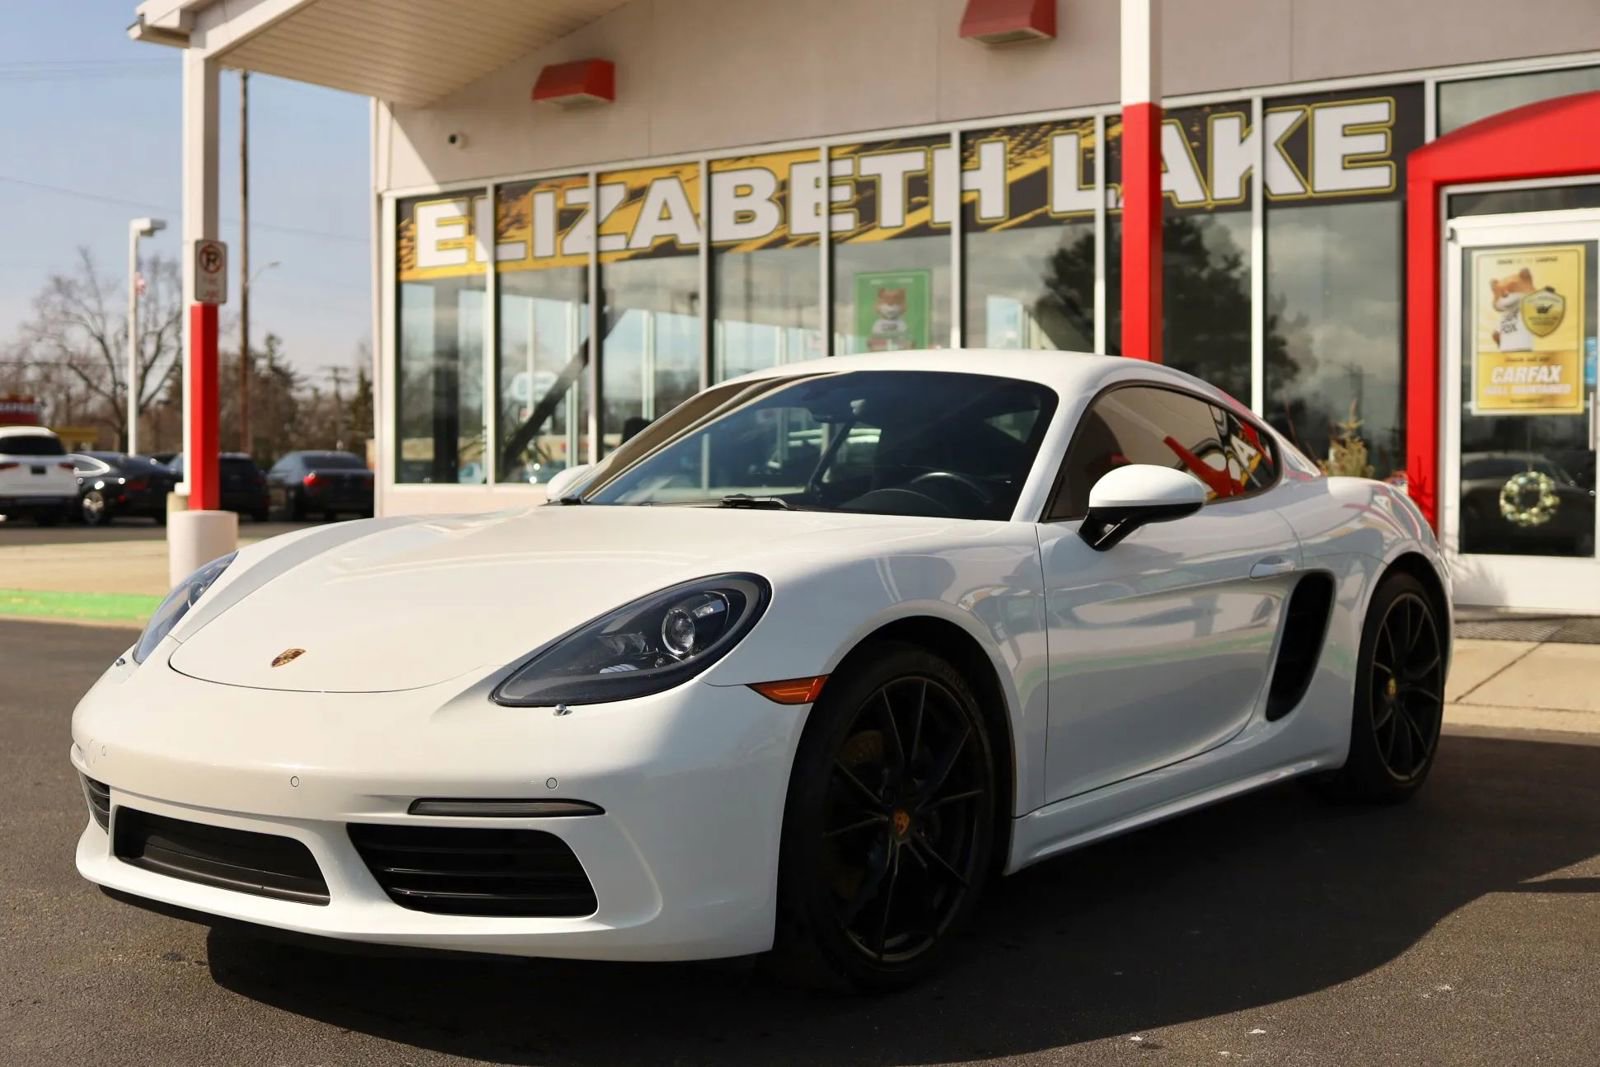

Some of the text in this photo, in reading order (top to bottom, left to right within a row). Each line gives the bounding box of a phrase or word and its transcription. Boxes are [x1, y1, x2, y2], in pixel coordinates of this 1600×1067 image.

[414, 97, 1395, 268] ELIZABETH LAKE
[1492, 365, 1562, 384] CARFAX
